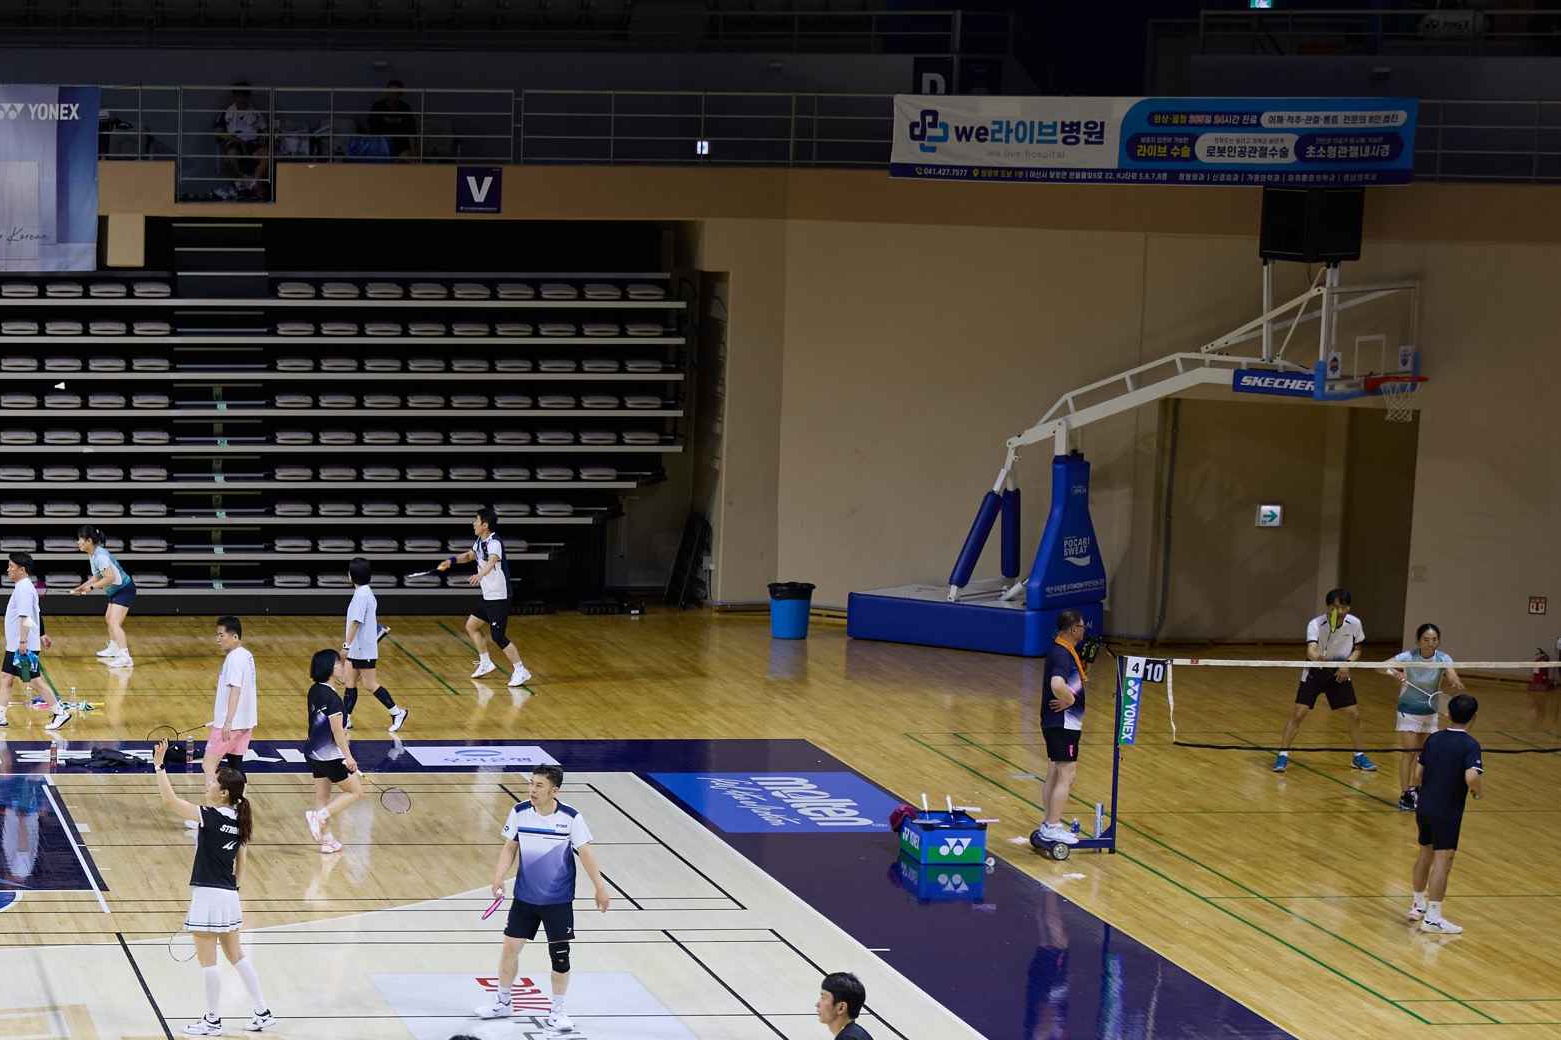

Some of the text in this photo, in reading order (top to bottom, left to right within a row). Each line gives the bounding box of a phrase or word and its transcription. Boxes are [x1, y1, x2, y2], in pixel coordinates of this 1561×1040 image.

[921, 73, 946, 94] D
[27, 103, 80, 121] YONEX
[955, 120, 1105, 146] we라이브병원
[1136, 144, 1167, 158] 라이브
[1206, 144, 1289, 158] 로봇인공관절수술
[466, 176, 494, 203] V
[1239, 375, 1315, 391] SKECHER
[1132, 662, 1140, 674] 4
[1145, 663, 1164, 682] 10
[1121, 703, 1137, 741] YONEX
[749, 776, 874, 827] molten
